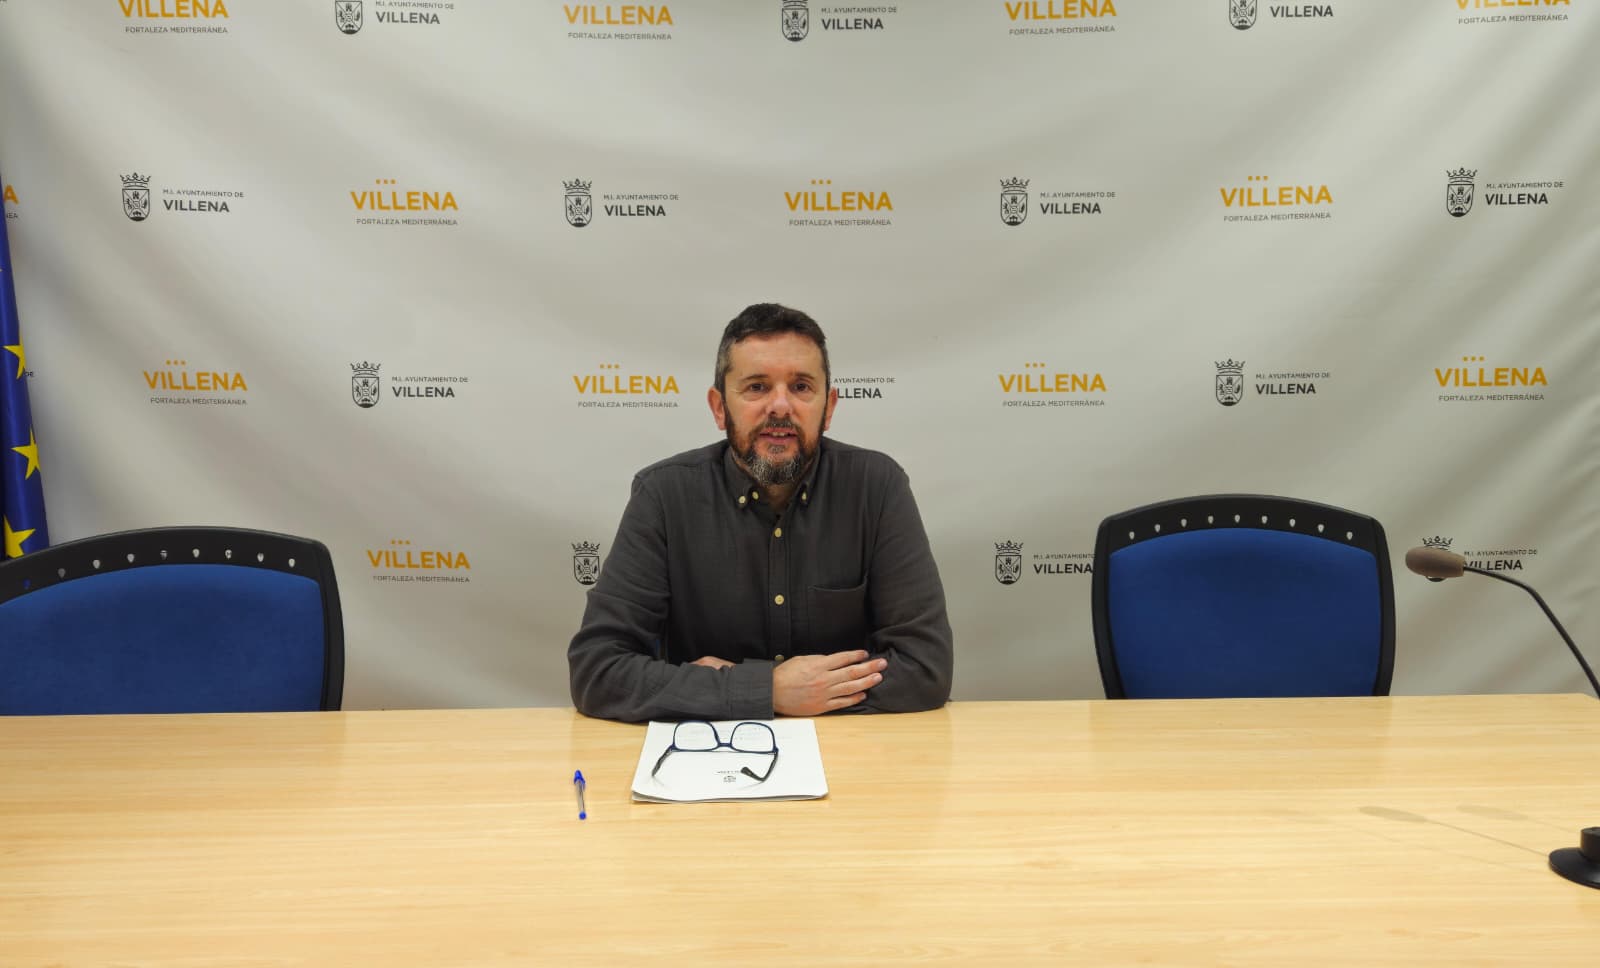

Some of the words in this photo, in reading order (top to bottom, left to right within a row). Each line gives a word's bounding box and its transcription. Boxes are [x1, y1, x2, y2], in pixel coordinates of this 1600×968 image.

[118, 0, 228, 18] VILLENA
[388, 1, 443, 9] AYUNTAMIENTO
[834, 6, 886, 14] AYUNTAMIENTO
[888, 6, 896, 14] DE
[1005, 0, 1117, 20] VILLENA
[564, 5, 673, 25] VILLENA
[1270, 5, 1333, 17] VILLENA
[376, 12, 440, 24] VILLENA
[1458, 15, 1506, 24] FORTALEZA
[822, 18, 883, 30] VILLENA
[126, 26, 168, 34] FORTALEZA
[568, 31, 612, 40] FORTALEZA
[1009, 27, 1054, 36] FORTALEZA
[177, 189, 232, 198] AYUNTAMIENTO
[1052, 191, 1105, 199] AYUNTAMIENTO
[1220, 185, 1332, 207] VILLENA
[1485, 193, 1548, 205] VILLENA
[163, 200, 229, 212] VILLENA
[351, 192, 458, 211] VILLENA
[785, 192, 893, 211] VILLENA
[605, 205, 666, 216] VILLENA
[1040, 203, 1101, 214] VILLENA
[789, 218, 832, 227] FORTALEZA
[1224, 214, 1268, 223] FORTALEZA
[144, 371, 247, 391] VILLENA
[835, 376, 884, 384] AYUNTAMIENTO
[1268, 372, 1320, 380] AYUNTAMIENTO
[1435, 368, 1547, 387] VILLENA
[573, 376, 679, 394] VILLENA
[999, 374, 1106, 392] VILLENA
[1256, 383, 1316, 394] VILLENA
[392, 387, 455, 397] VILLENA
[837, 387, 883, 399] LLENA
[151, 396, 191, 405] FORTALEZA
[1003, 399, 1046, 408] FORTALEZA
[1439, 394, 1484, 402] FORTALEZA
[578, 400, 621, 408] FORTALEZA
[1477, 549, 1527, 557] AYUNTAMIENTO
[367, 550, 470, 569] VILLENA
[1033, 563, 1093, 575] VILLENA
